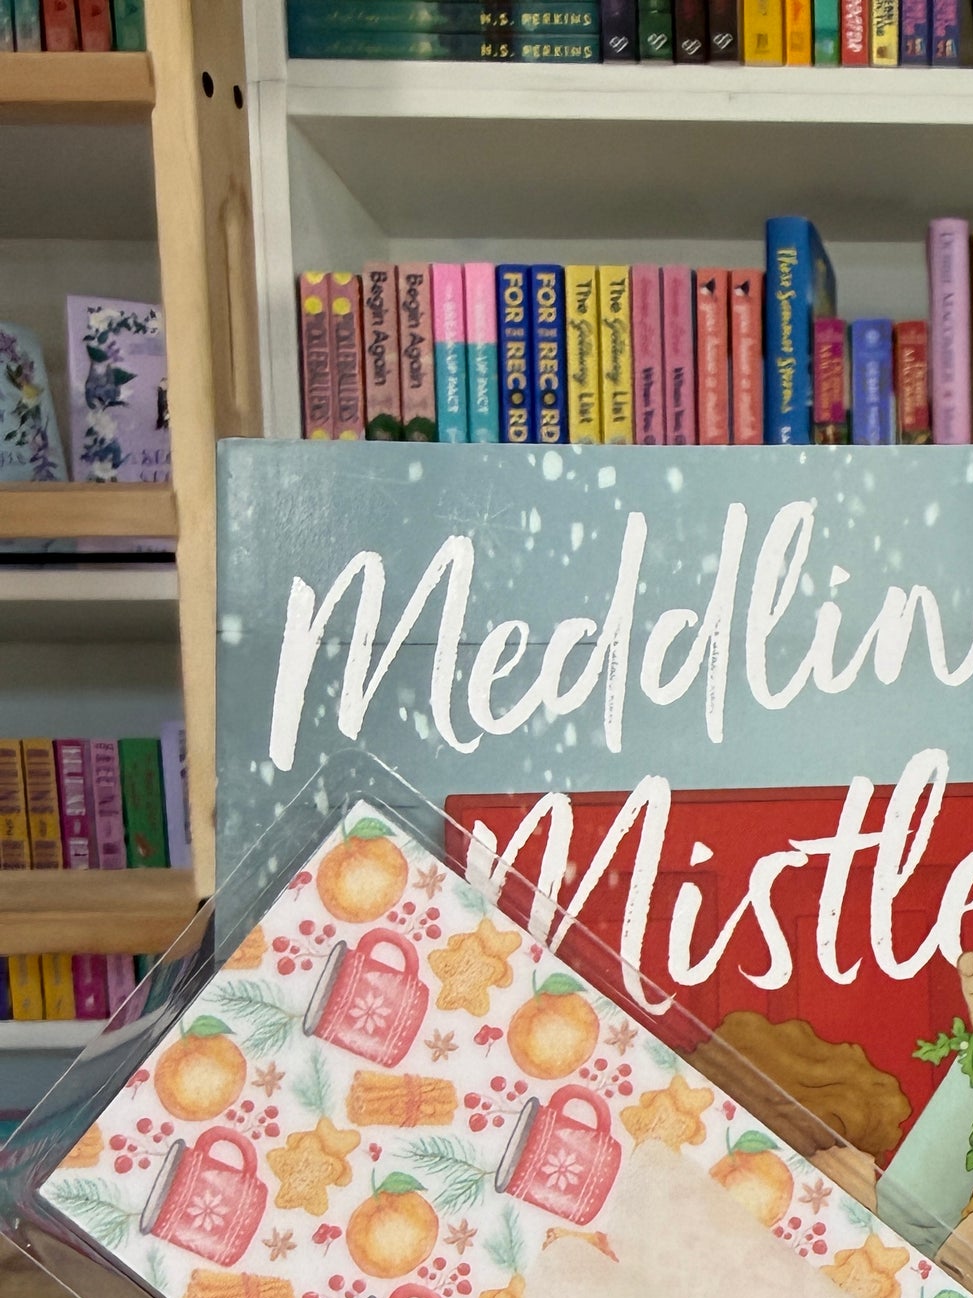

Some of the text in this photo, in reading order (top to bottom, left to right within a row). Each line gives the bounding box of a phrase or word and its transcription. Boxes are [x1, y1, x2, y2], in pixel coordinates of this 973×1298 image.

[503, 272, 524, 323] FOR
[536, 272, 557, 323] FOR
[576, 279, 593, 314] The
[609, 278, 626, 313] The
[367, 272, 391, 385] Begin Again
[403, 274, 426, 389] Begin Again
[579, 392, 594, 424] List
[612, 391, 628, 422] List
